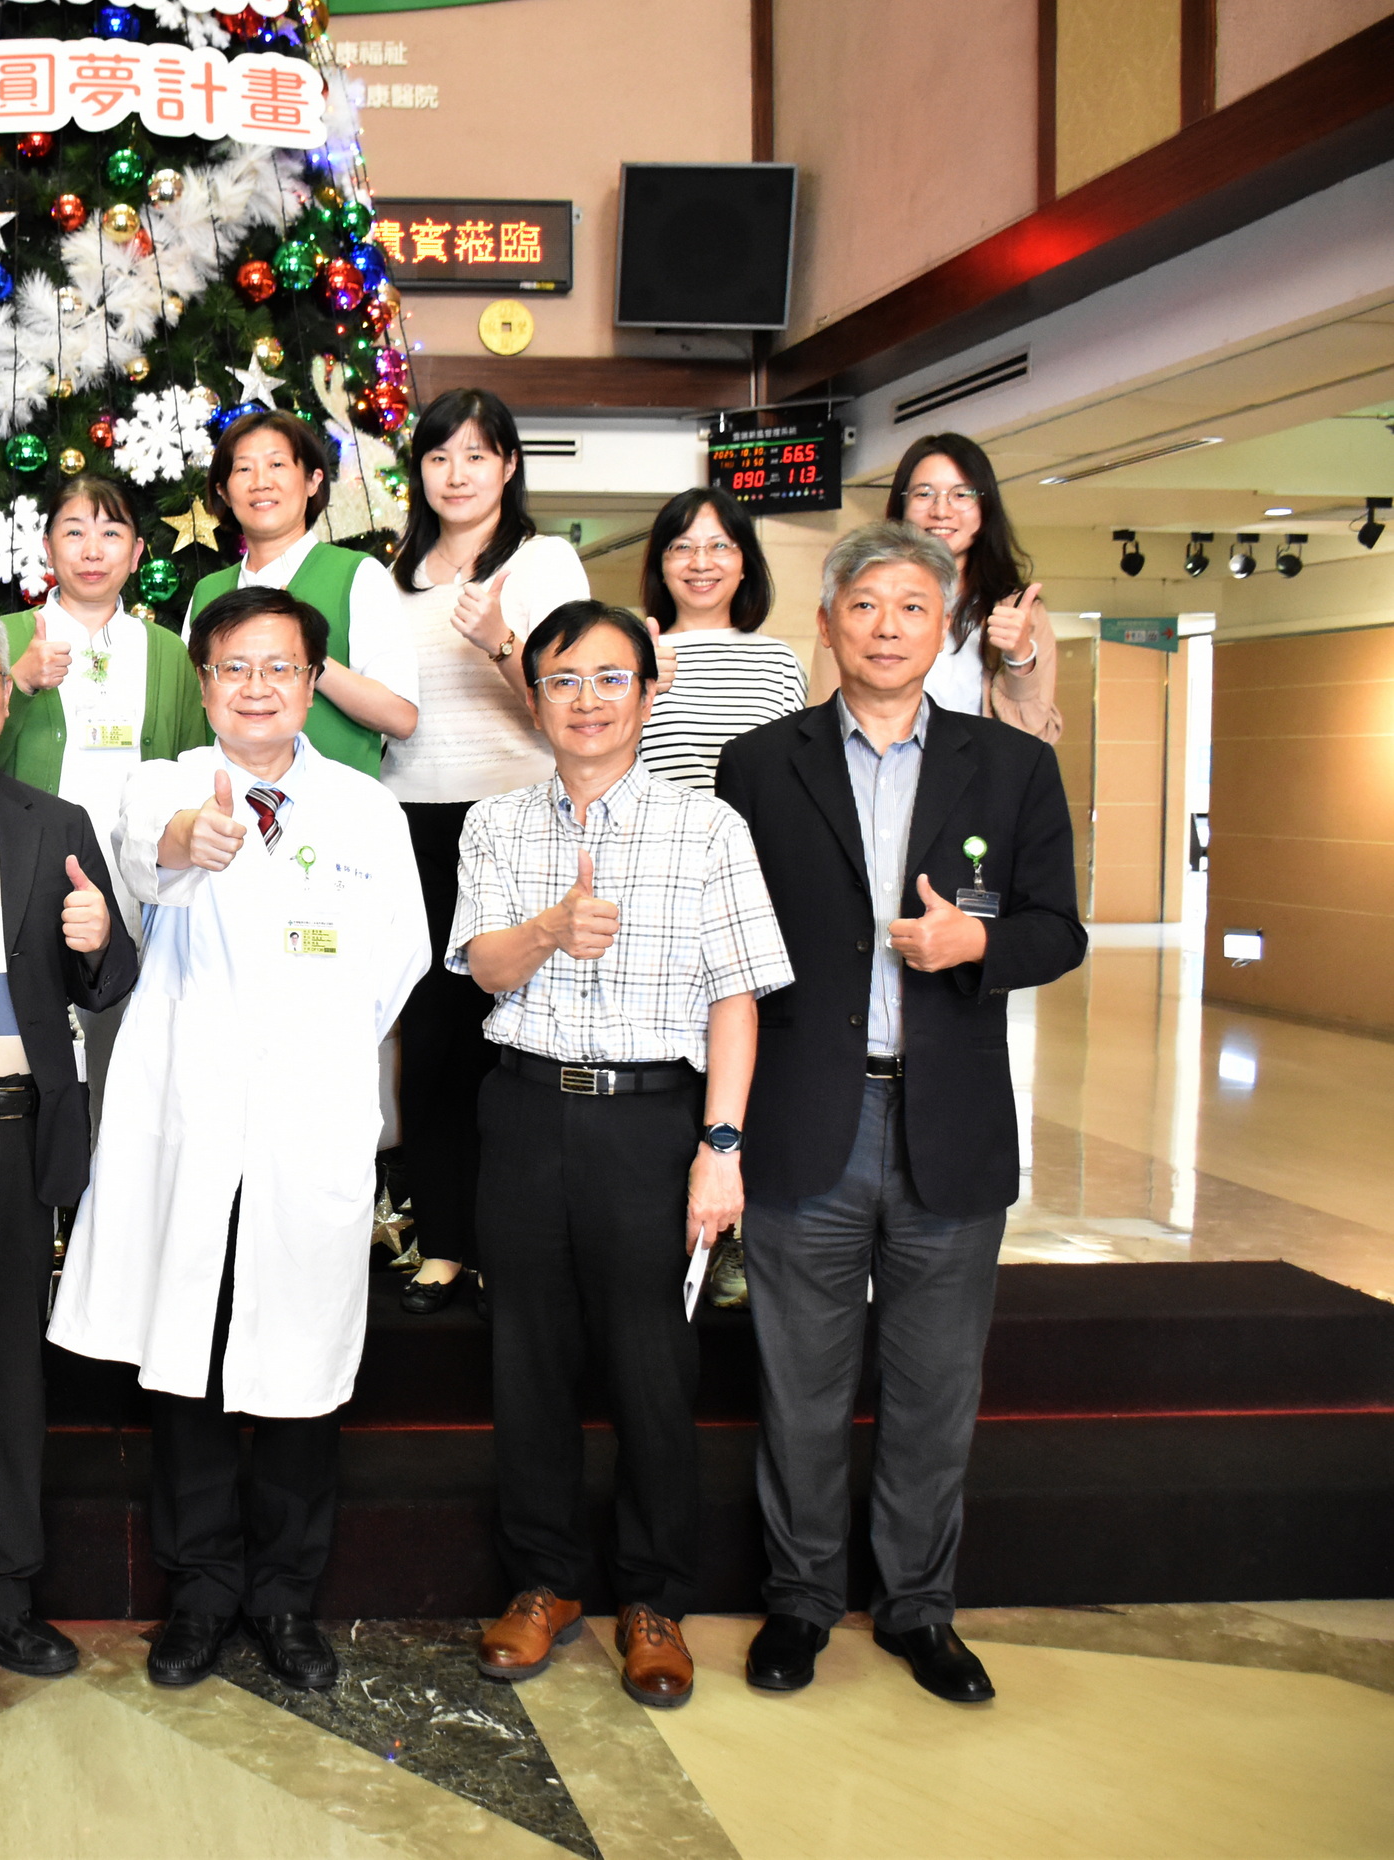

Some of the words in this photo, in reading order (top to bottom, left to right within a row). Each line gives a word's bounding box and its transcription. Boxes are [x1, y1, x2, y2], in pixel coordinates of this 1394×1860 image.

[356, 83, 439, 108] 康醫院
[372, 218, 542, 264] 貴賓蒞臨
[733, 470, 765, 490] 890
